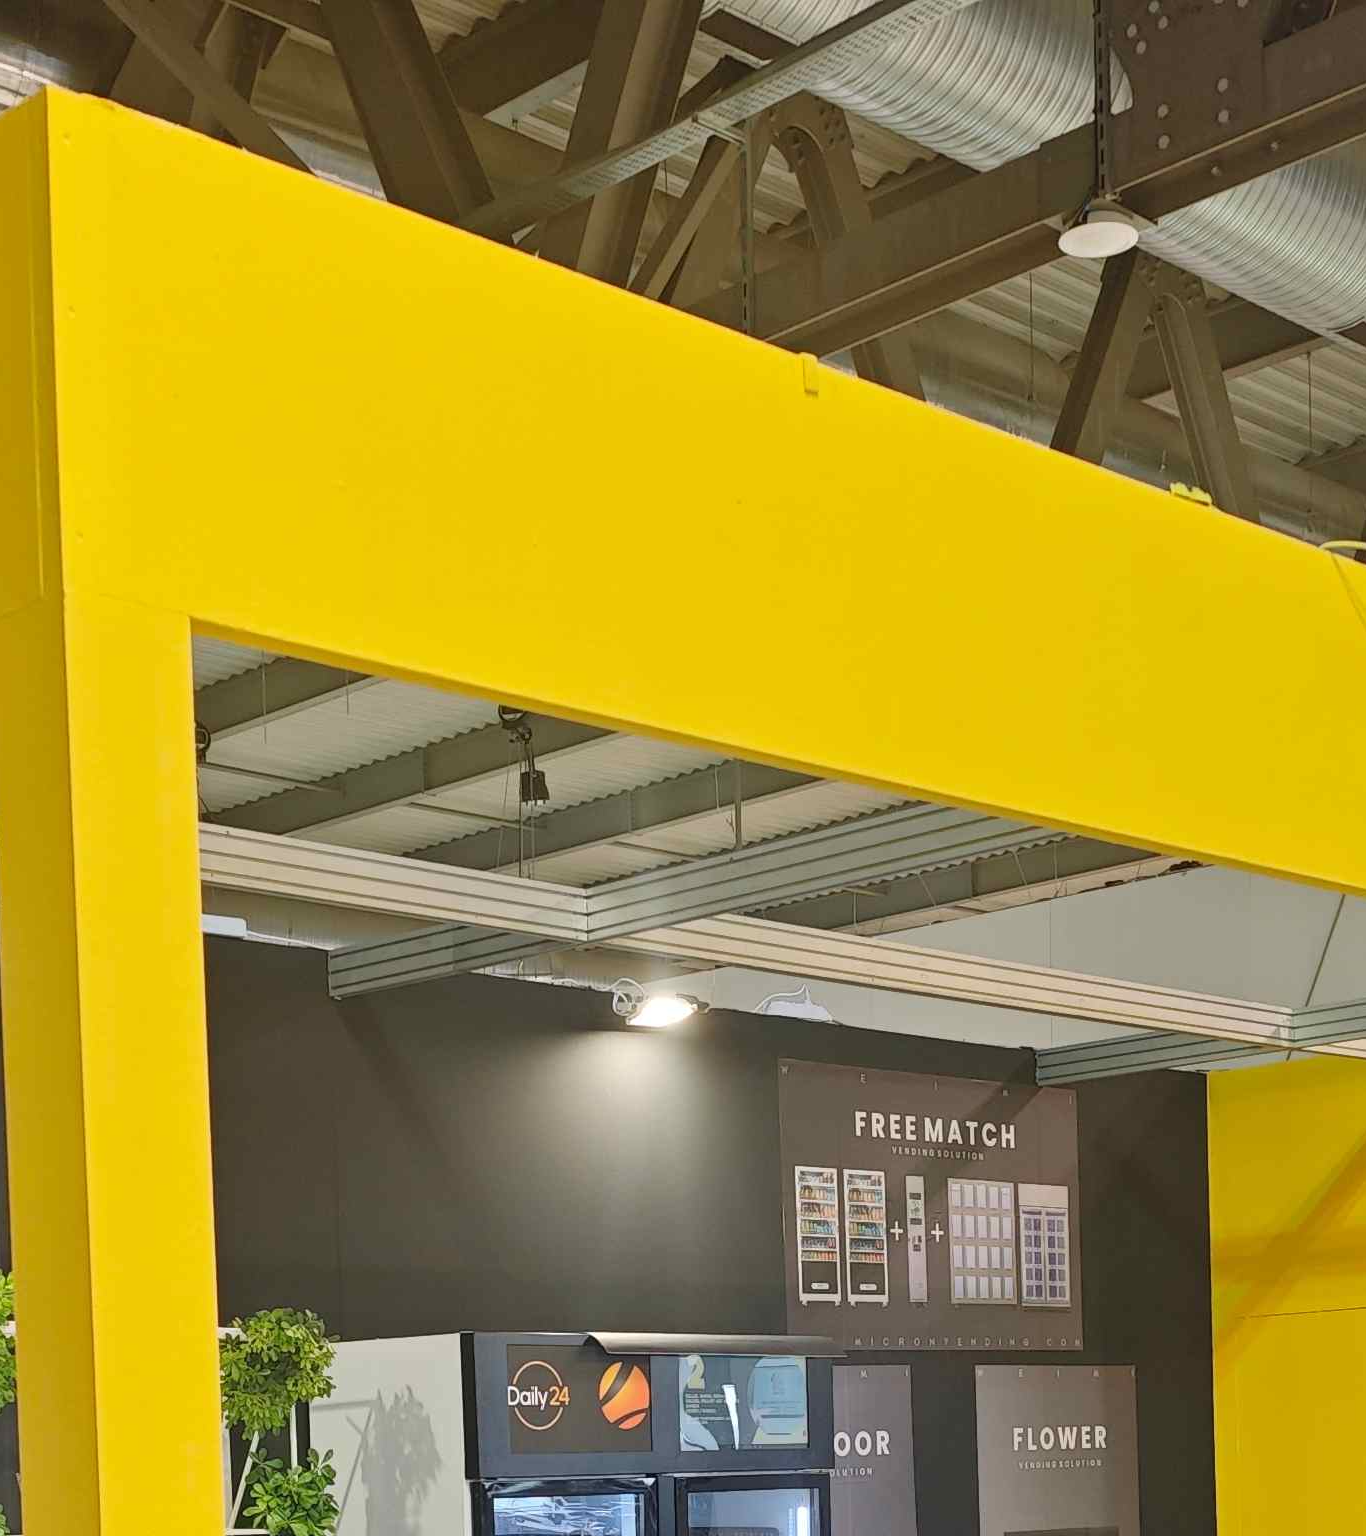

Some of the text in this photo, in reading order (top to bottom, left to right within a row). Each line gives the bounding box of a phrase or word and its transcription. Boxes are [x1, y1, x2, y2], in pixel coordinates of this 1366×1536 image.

[853, 1110, 1017, 1149] FREE MATCH
[891, 1145, 985, 1161] VENDING SOLUTION
[833, 1429, 892, 1457] OOR
[1012, 1425, 1107, 1451] FLOWER
[829, 1467, 874, 1479] OLUTION
